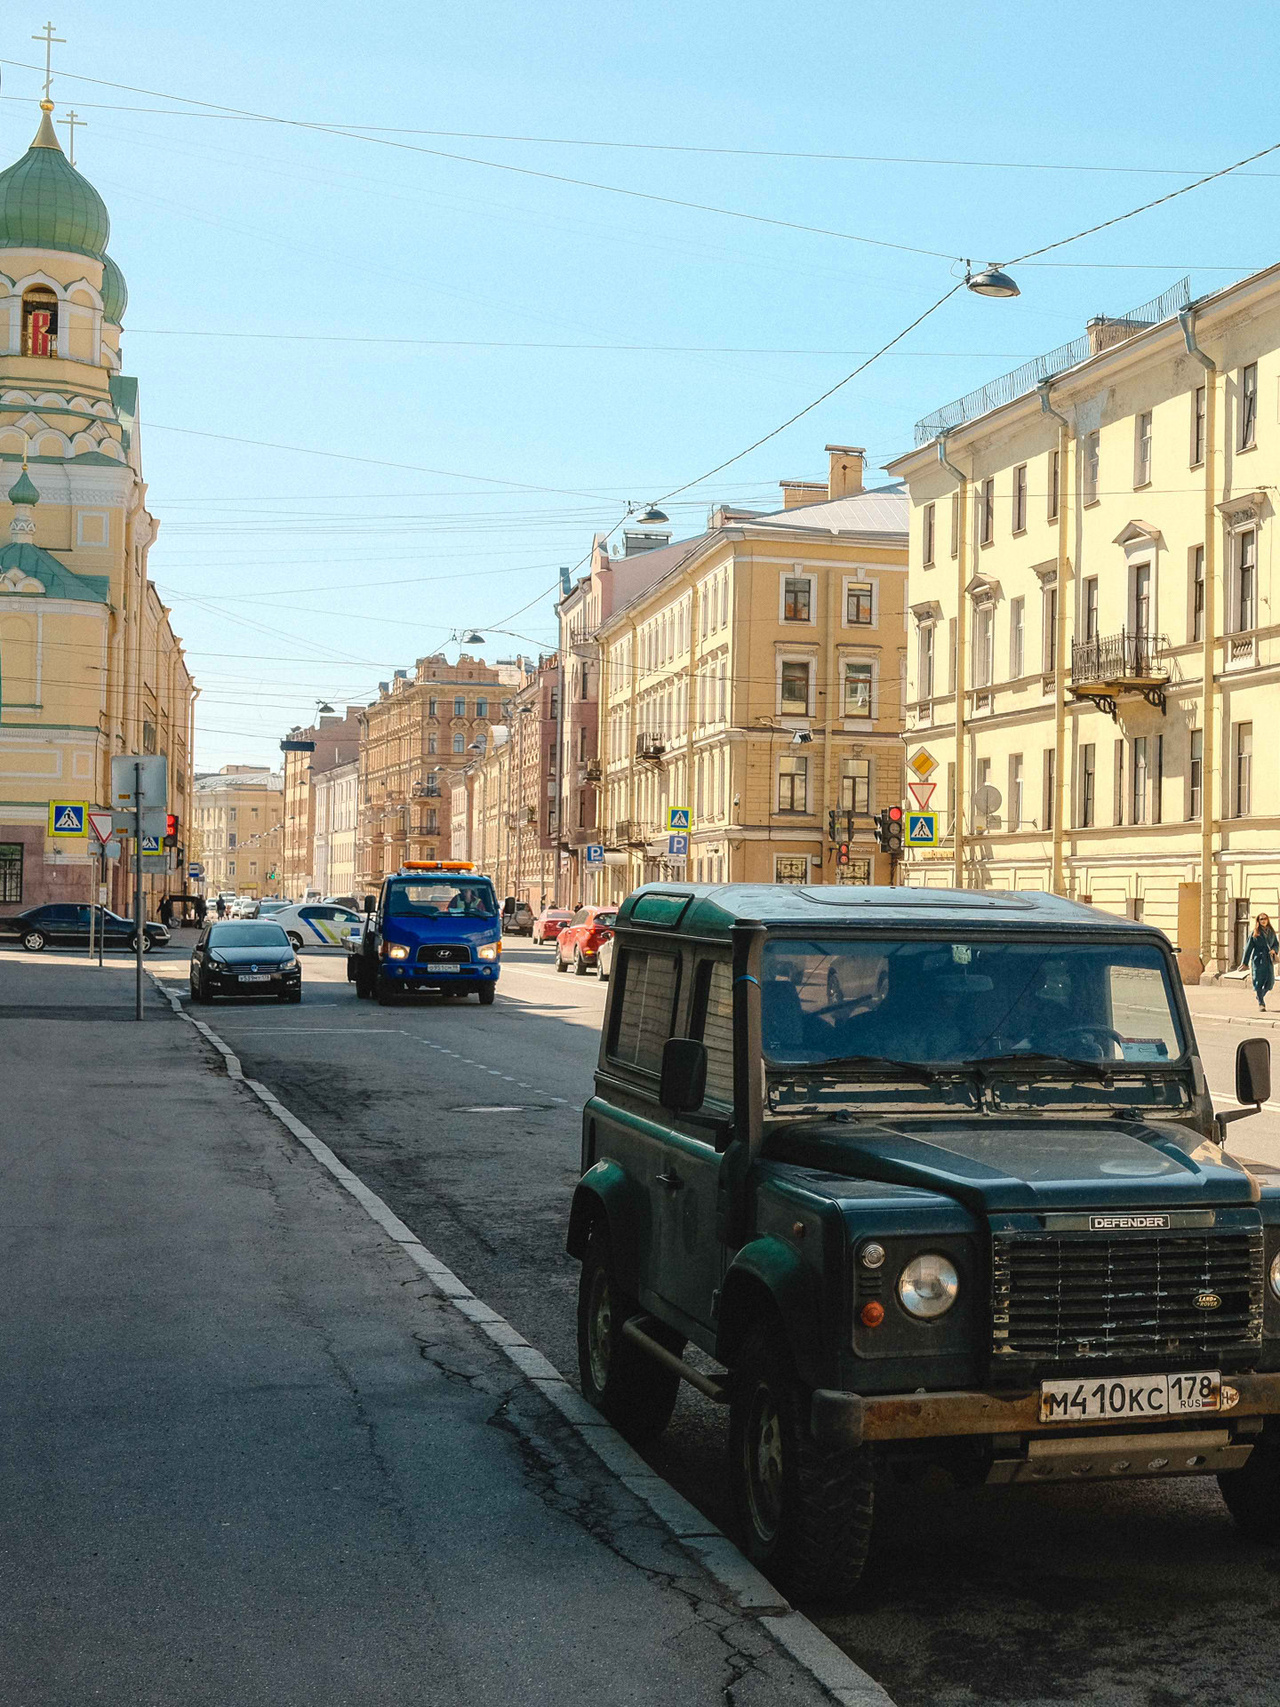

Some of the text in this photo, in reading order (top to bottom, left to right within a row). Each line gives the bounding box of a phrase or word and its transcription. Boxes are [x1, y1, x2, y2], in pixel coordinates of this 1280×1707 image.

[1094, 1217, 1164, 1228] DEFENDER
[1050, 1375, 1213, 1416] М410КС 178
[1180, 1398, 1202, 1409] RUS
